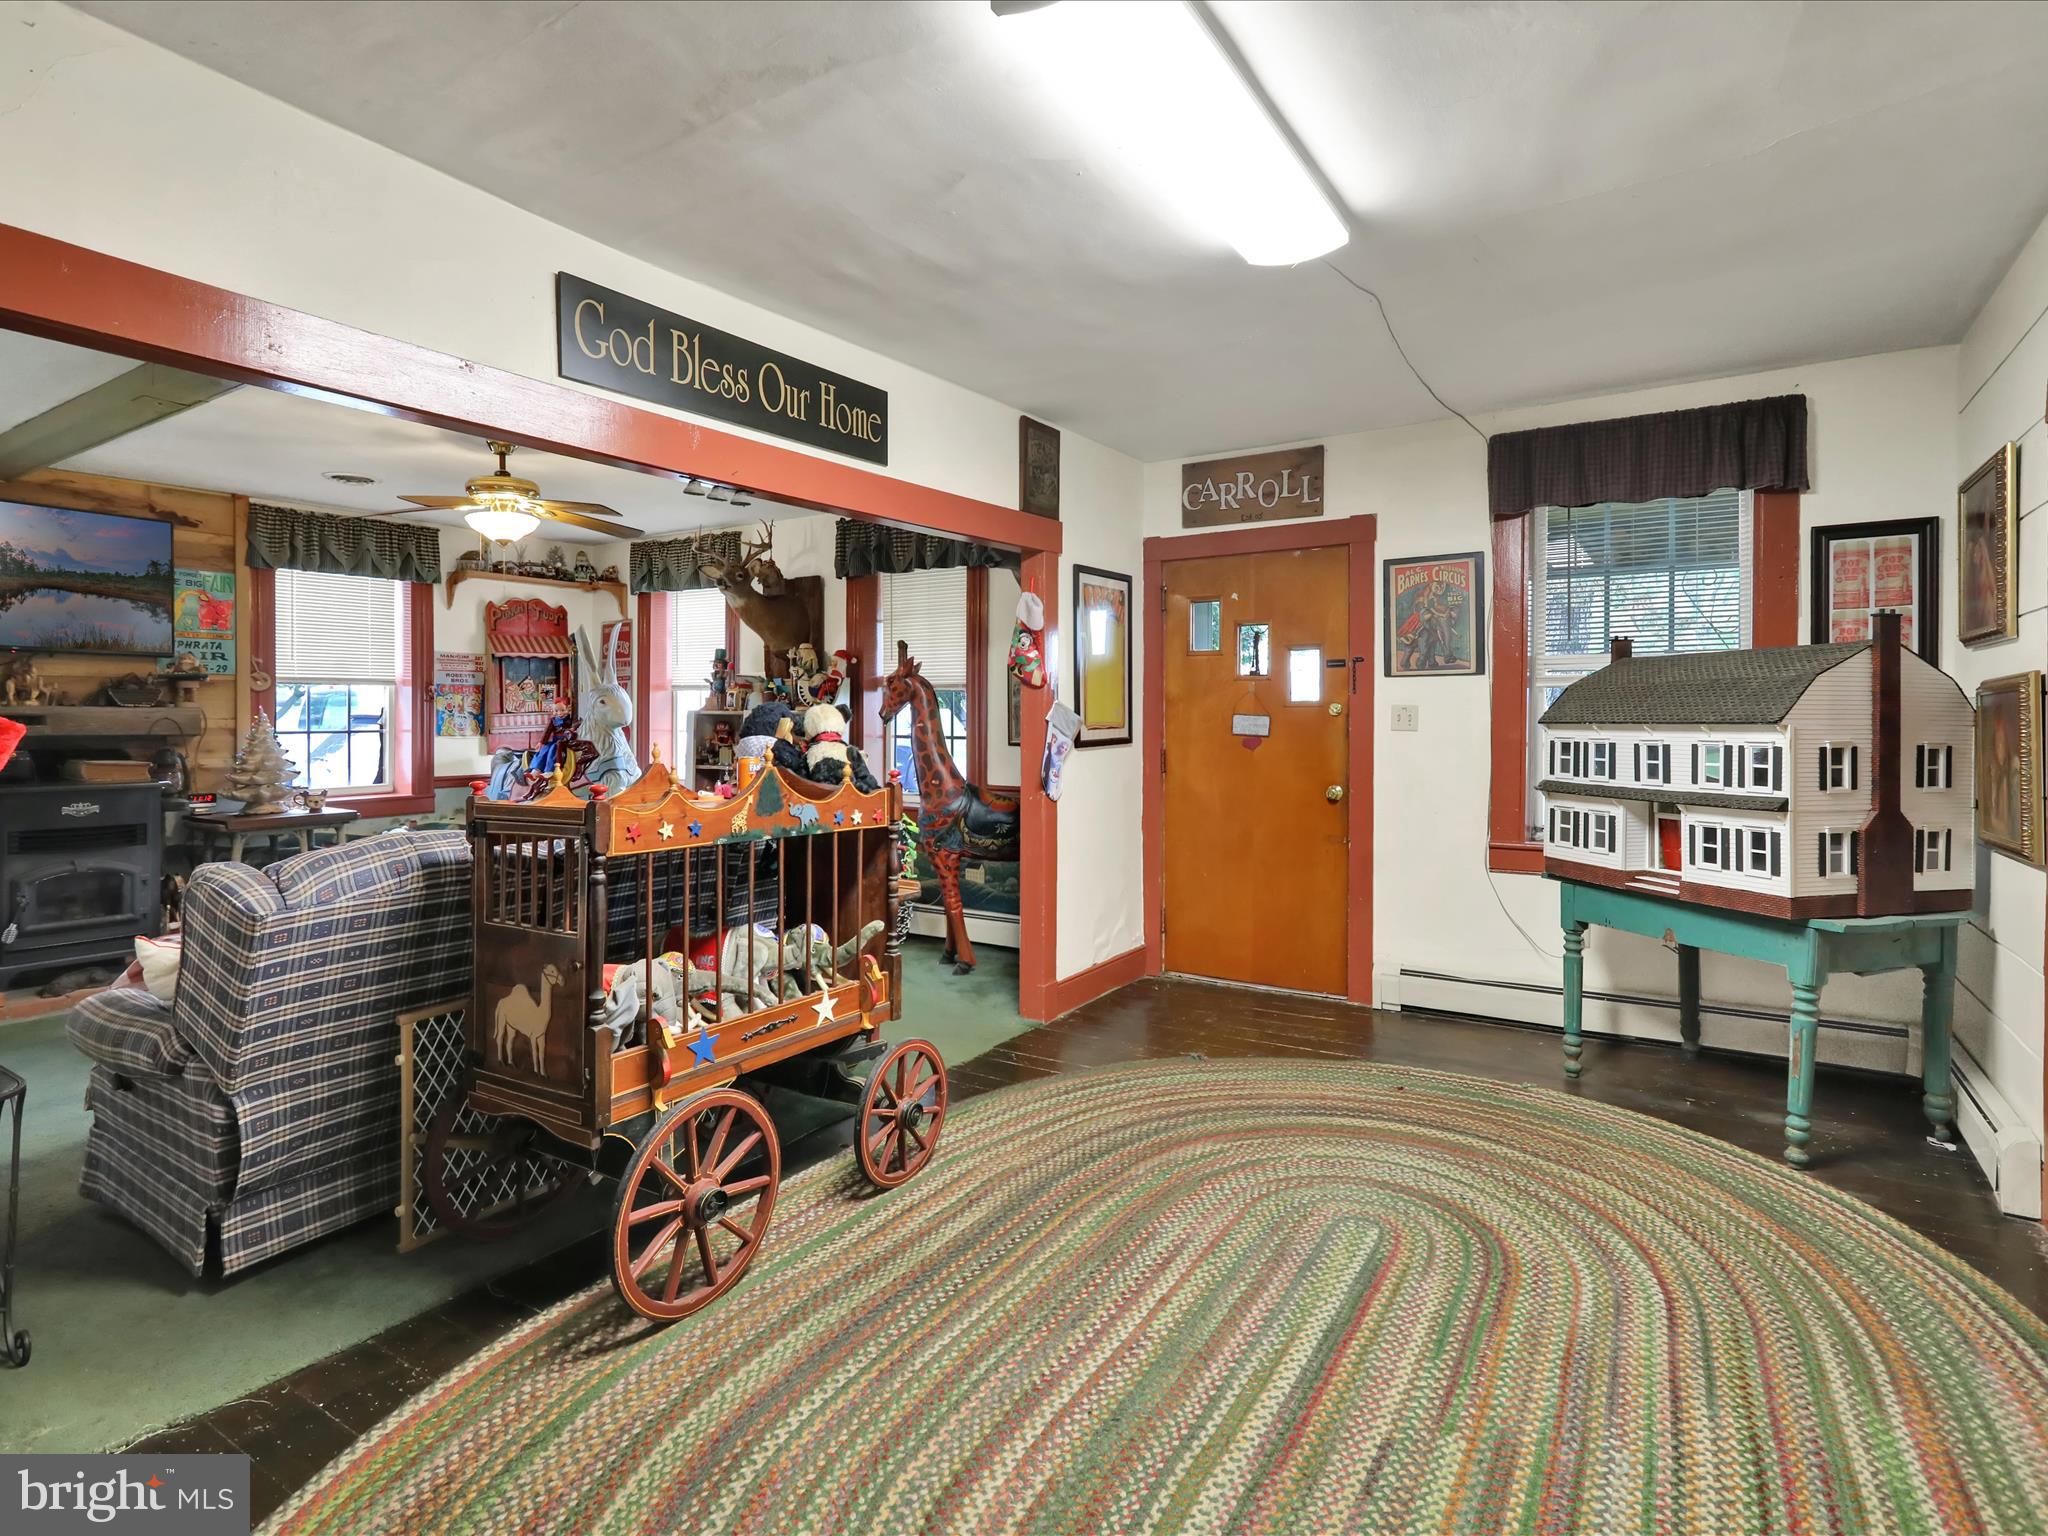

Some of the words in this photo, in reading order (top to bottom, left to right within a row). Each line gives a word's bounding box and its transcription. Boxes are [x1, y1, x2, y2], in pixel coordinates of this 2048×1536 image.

[574, 299, 656, 376] God
[670, 328, 750, 403] Bless
[758, 362, 810, 421] Our
[818, 381, 882, 443] Home
[1182, 468, 1321, 511] CARROLL
[1881, 555, 1905, 564] POP
[185, 579, 203, 588] BIG
[203, 573, 233, 594] FAIR
[1397, 571, 1428, 595] BARNES
[1432, 566, 1466, 588] CIRCUS
[1839, 627, 1860, 636] POP
[177, 640, 223, 650] PHRATA
[602, 640, 630, 656] CCUS
